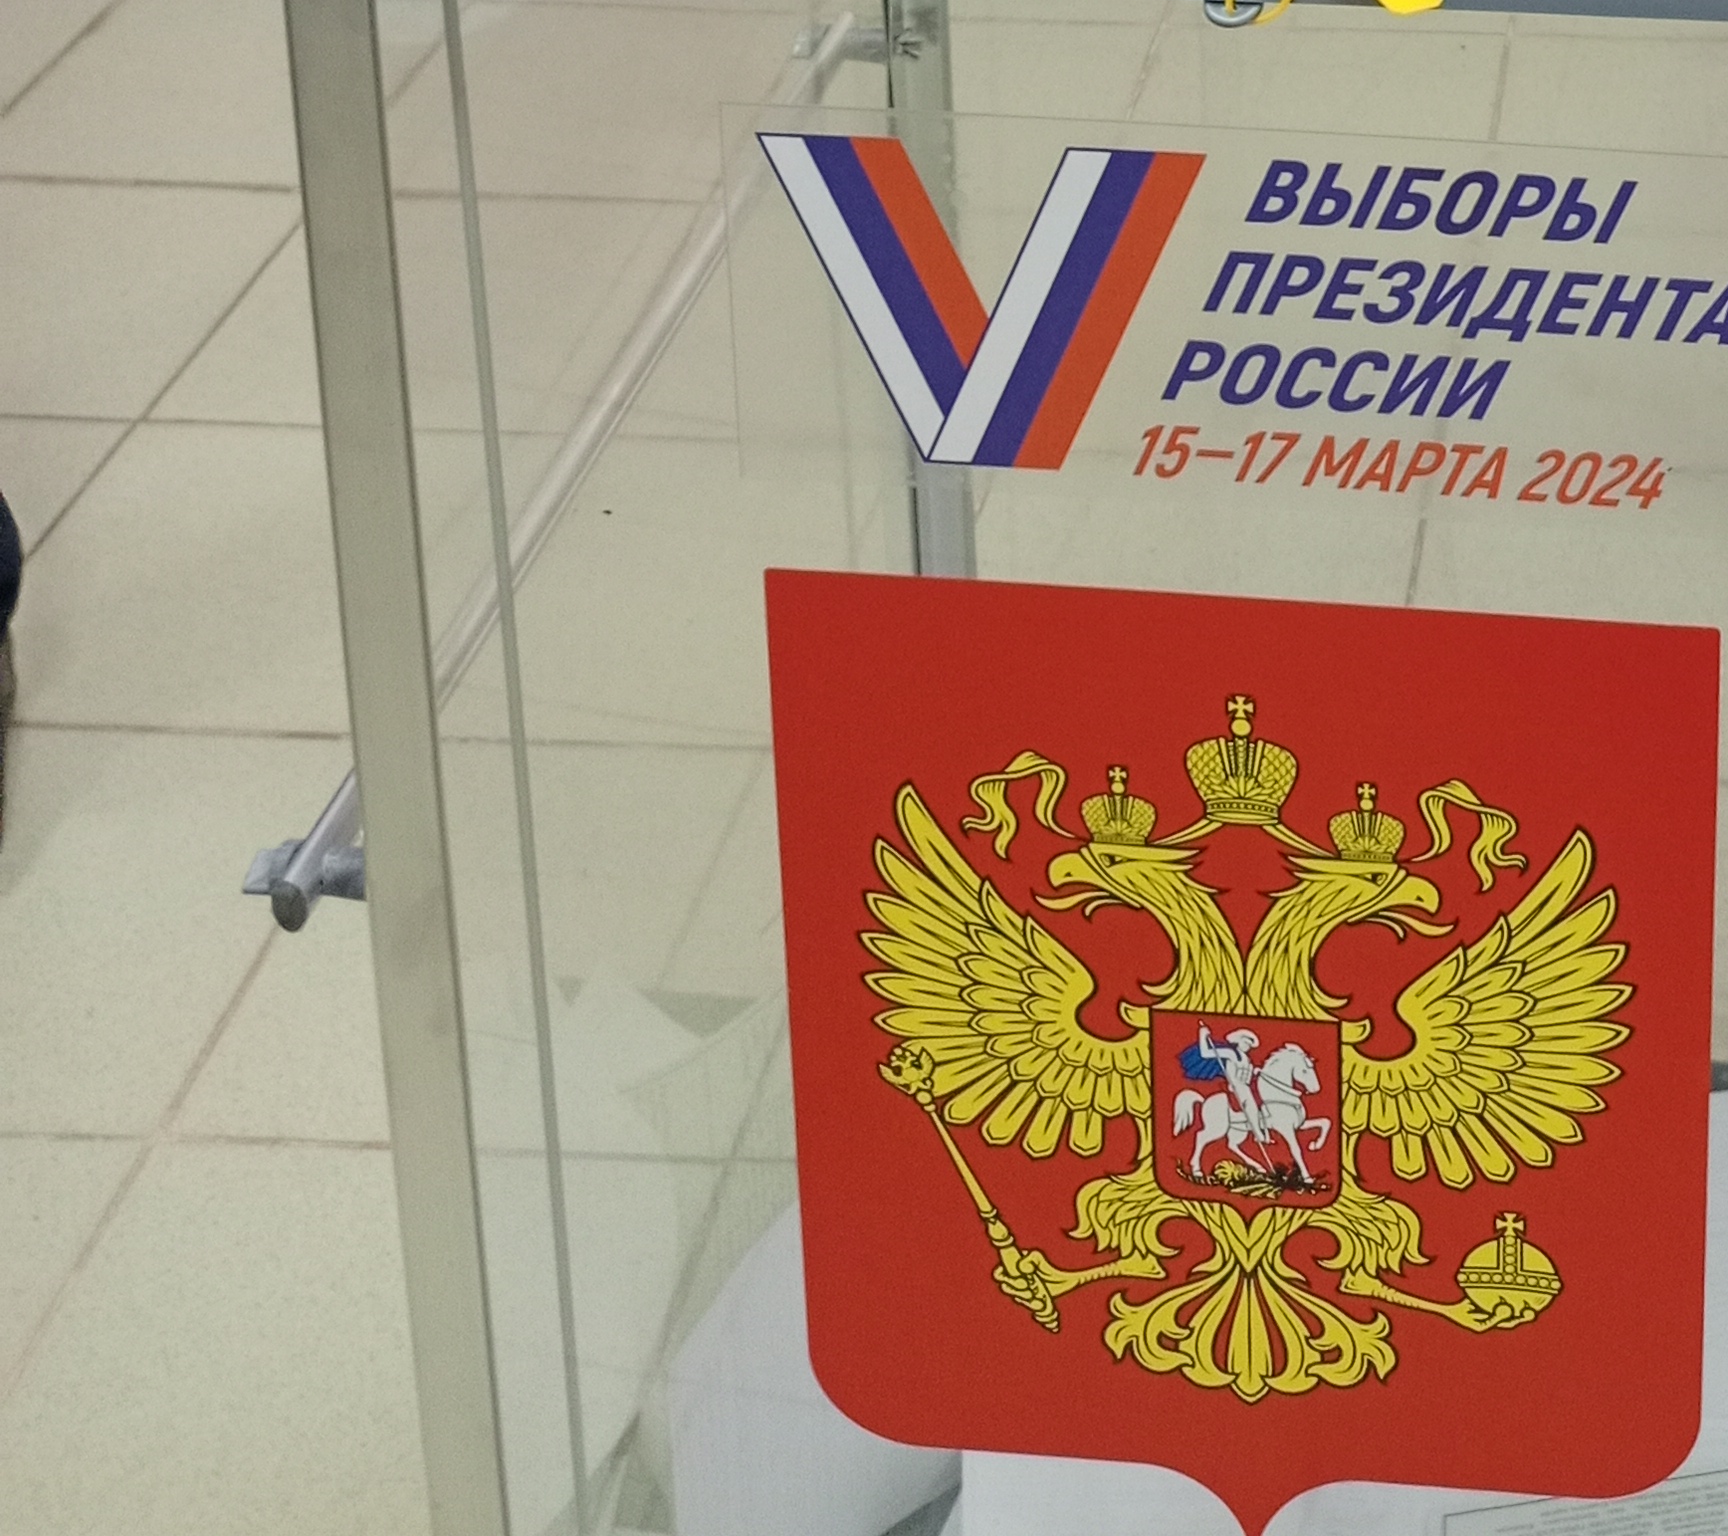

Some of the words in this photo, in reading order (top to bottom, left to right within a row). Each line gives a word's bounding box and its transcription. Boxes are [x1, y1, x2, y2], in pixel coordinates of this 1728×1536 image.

[1245, 160, 1637, 244] ВЫБОРЫ
[1161, 340, 1511, 420] РОССИИ
[1301, 435, 1509, 500] МАРТА
[1515, 449, 1667, 510] 2024
